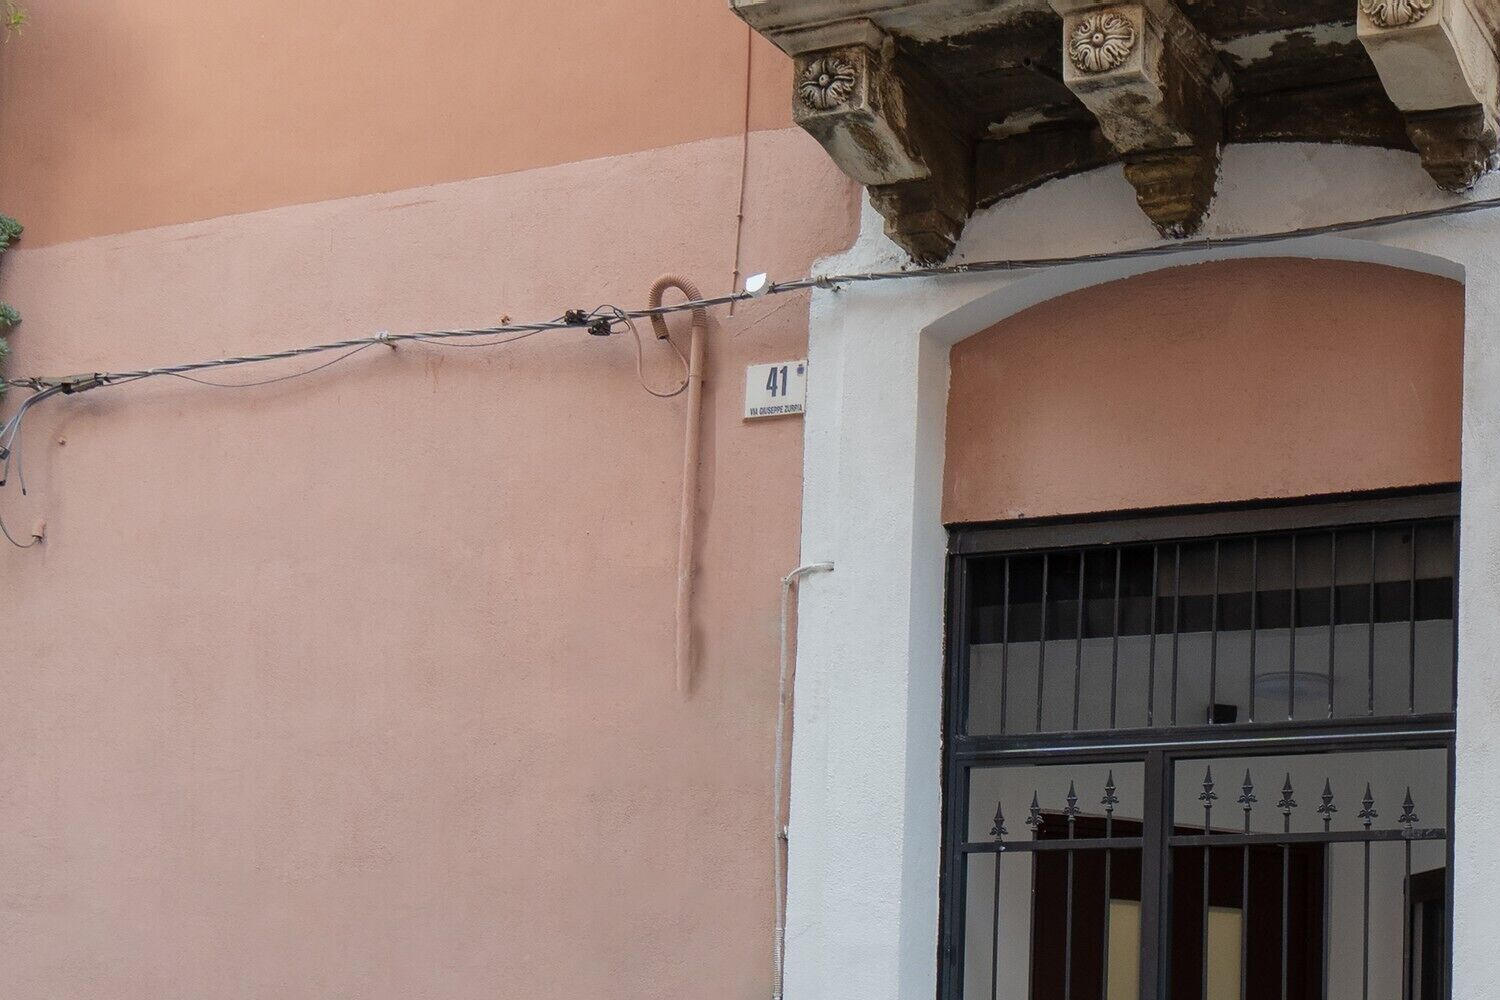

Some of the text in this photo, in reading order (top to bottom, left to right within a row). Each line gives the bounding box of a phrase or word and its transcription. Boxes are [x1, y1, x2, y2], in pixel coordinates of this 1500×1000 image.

[766, 365, 788, 397] 41
[750, 407, 758, 416] VIA
[759, 405, 784, 415] GIUSEPPE
